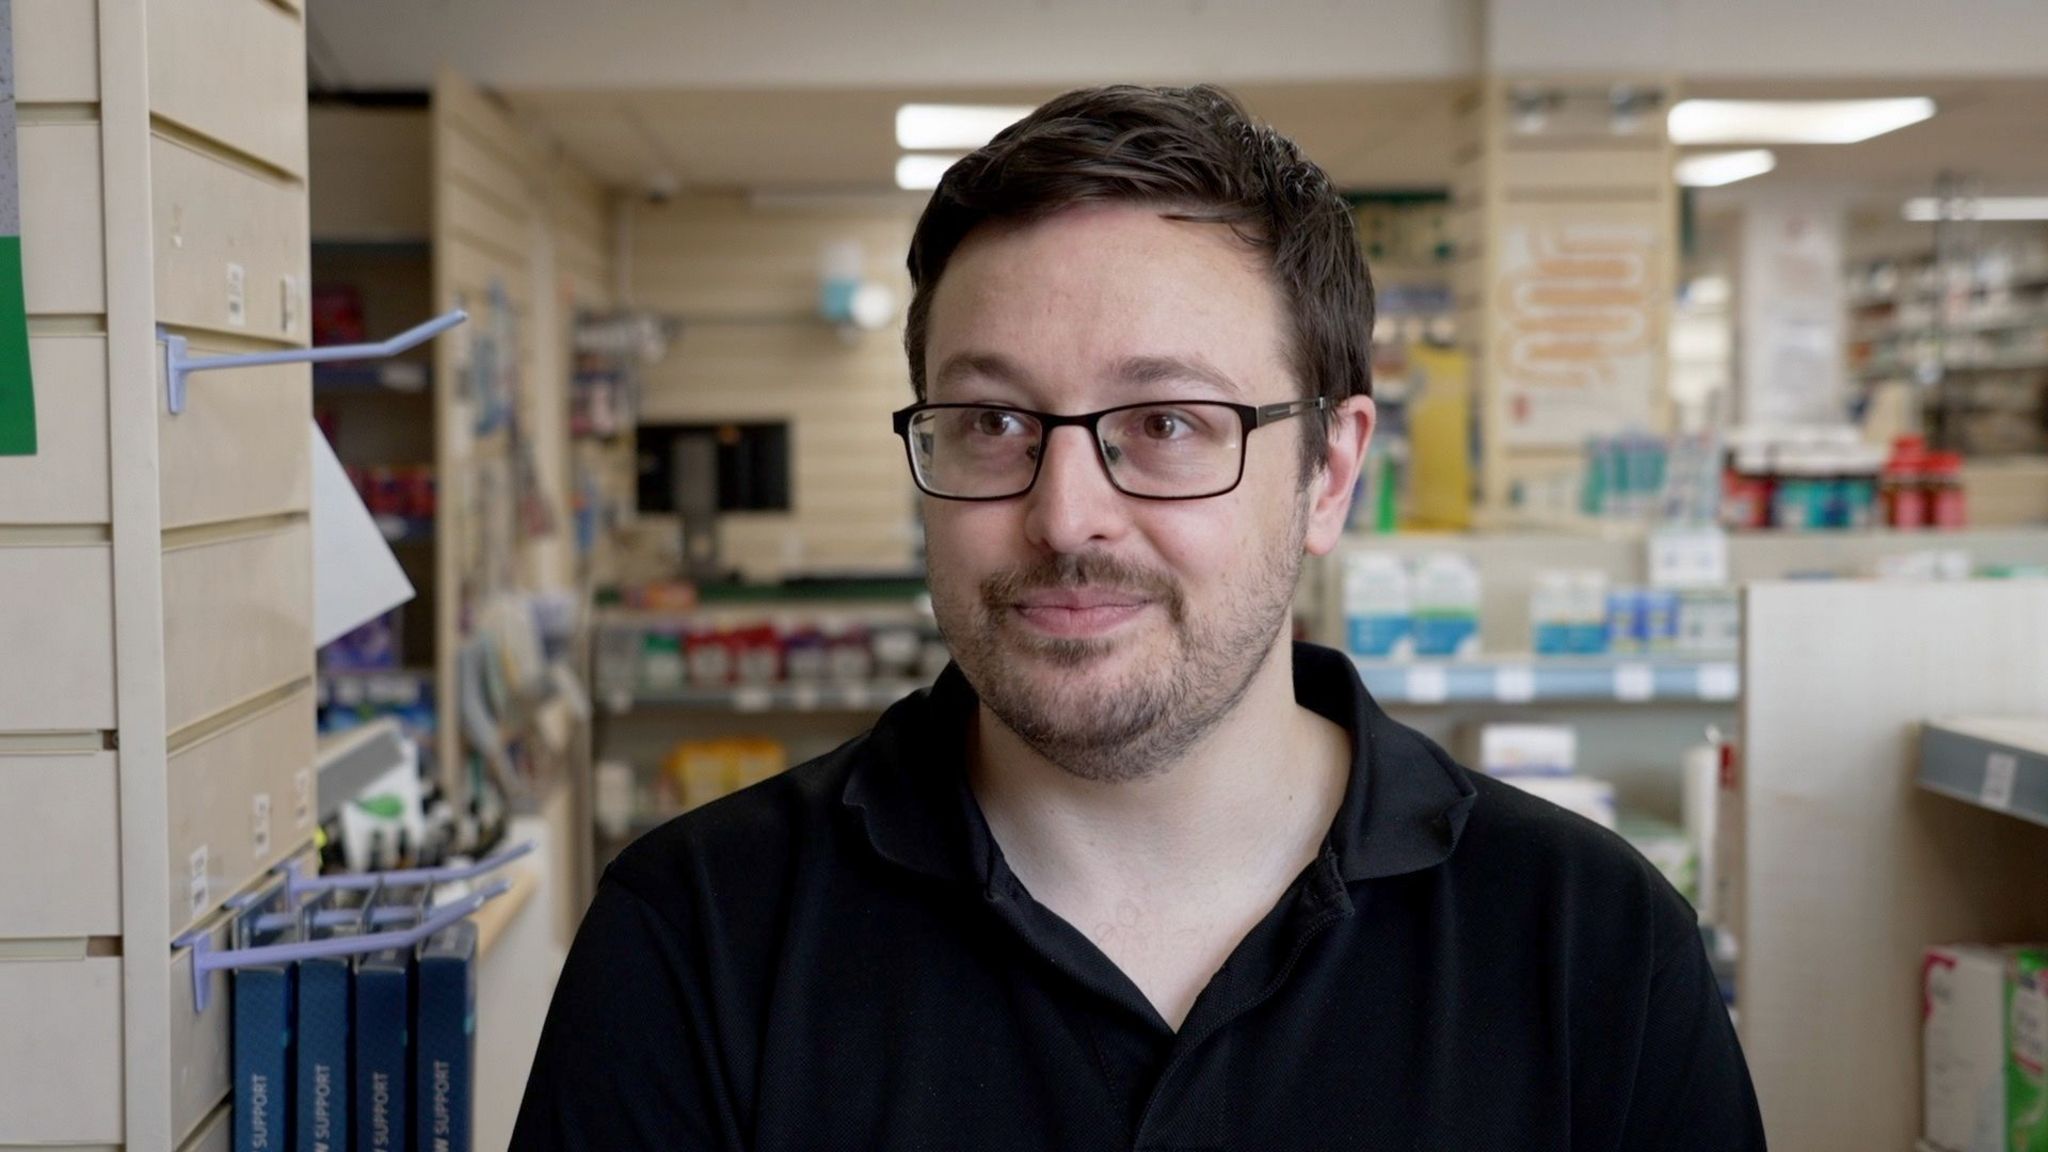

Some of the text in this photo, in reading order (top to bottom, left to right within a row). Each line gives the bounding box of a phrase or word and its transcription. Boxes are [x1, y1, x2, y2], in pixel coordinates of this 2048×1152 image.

[252, 1074, 267, 1148] SUPPORT
[315, 1065, 330, 1139] SUPPORT
[373, 1073, 389, 1145] SUPPORT
[433, 1061, 449, 1135] SUPPORT
